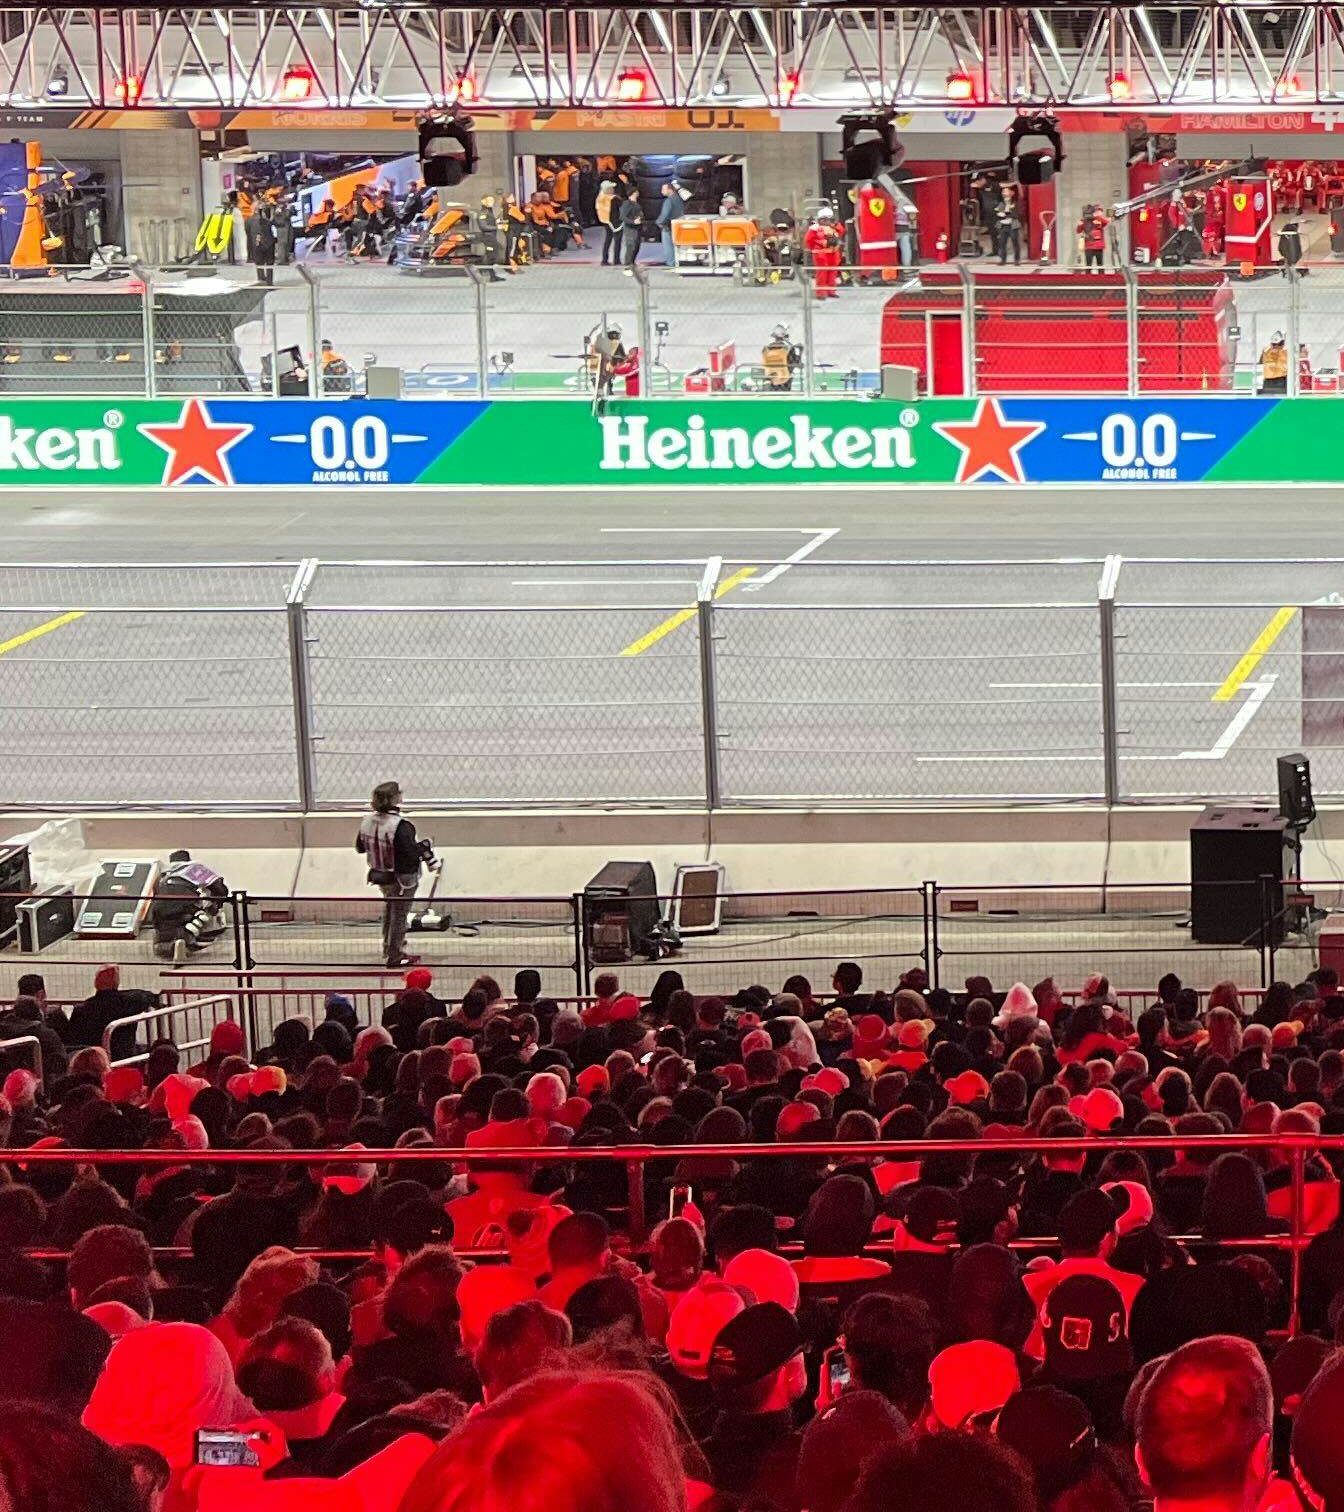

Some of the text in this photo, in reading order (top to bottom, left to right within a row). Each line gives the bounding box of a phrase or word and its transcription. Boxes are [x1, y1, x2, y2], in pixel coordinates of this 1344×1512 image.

[1180, 112, 1305, 130] HAMILTON
[311, 416, 388, 469] 0.0
[1102, 414, 1177, 467] 0.0
[312, 470, 389, 482] ALCOHOL FREE
[1102, 467, 1177, 480] ALCOHOL FREE
